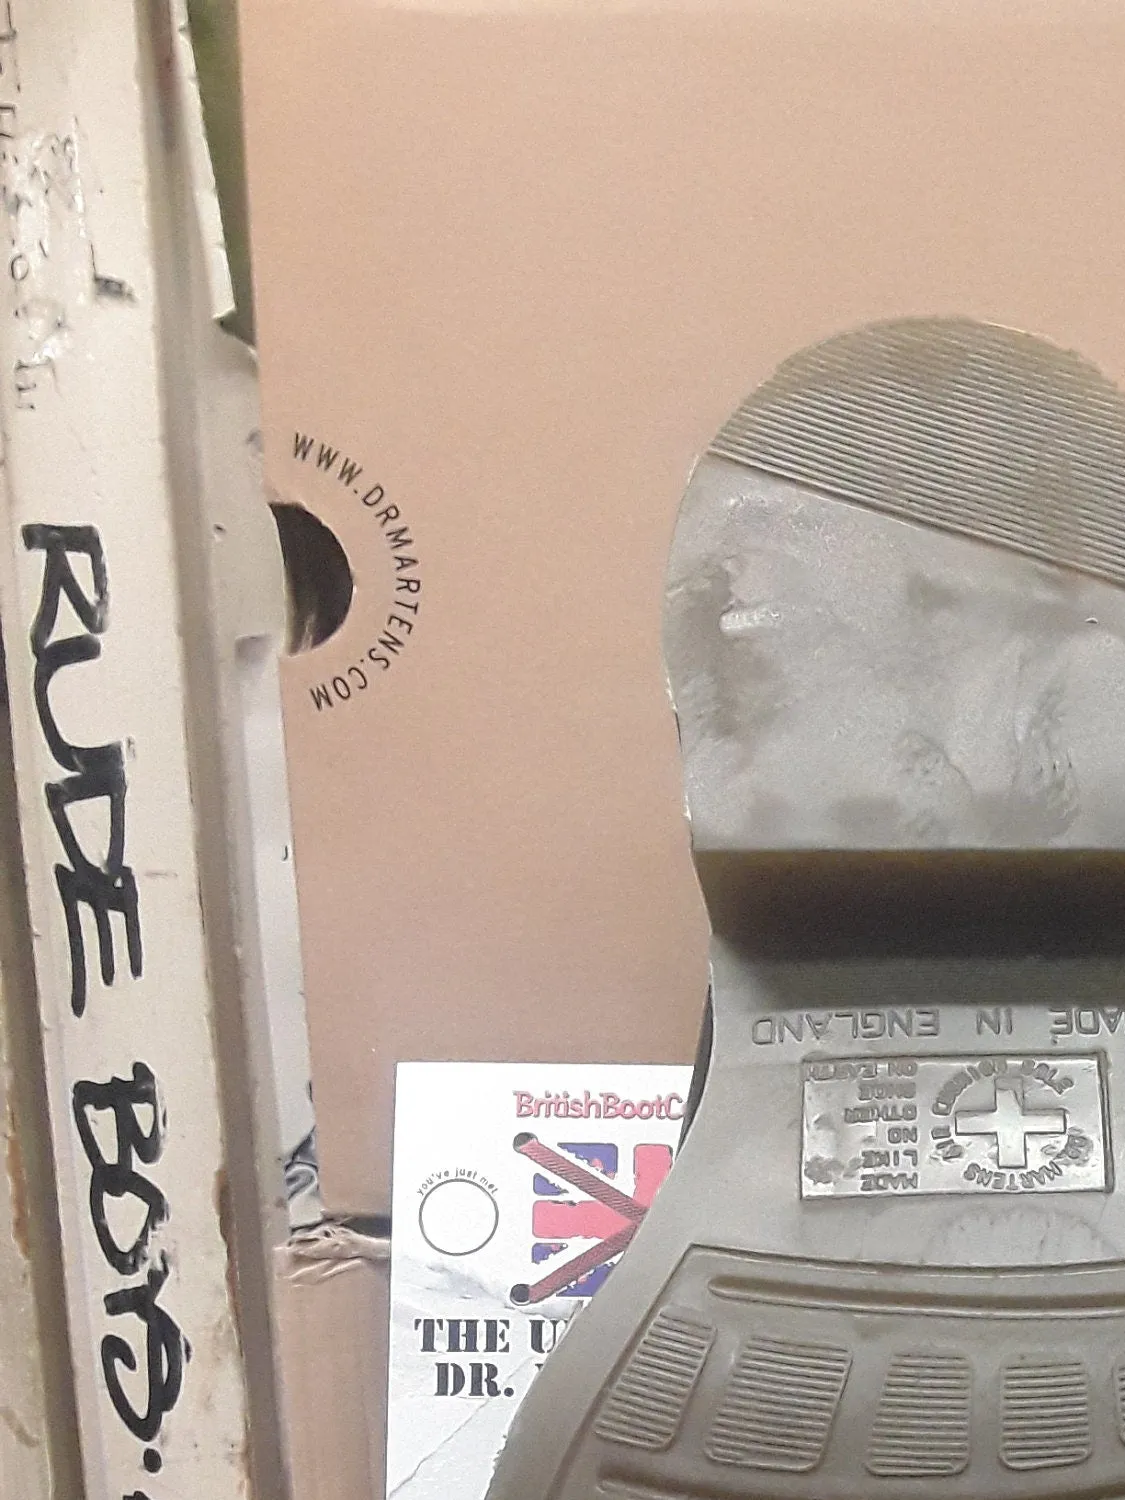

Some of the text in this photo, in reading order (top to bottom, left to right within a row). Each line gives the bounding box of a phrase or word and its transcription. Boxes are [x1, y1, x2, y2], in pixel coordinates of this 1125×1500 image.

[293, 432, 421, 711] WWW.DRMARTENS.COM
[752, 1008, 940, 1046] ENGLAND
[976, 1007, 1014, 1035] IN
[888, 1127, 918, 1144] NO
[860, 1149, 918, 1168] LIKE
[860, 1173, 918, 1190] MADE
[414, 1318, 510, 1354] THE
[434, 1361, 515, 1398] DR.
